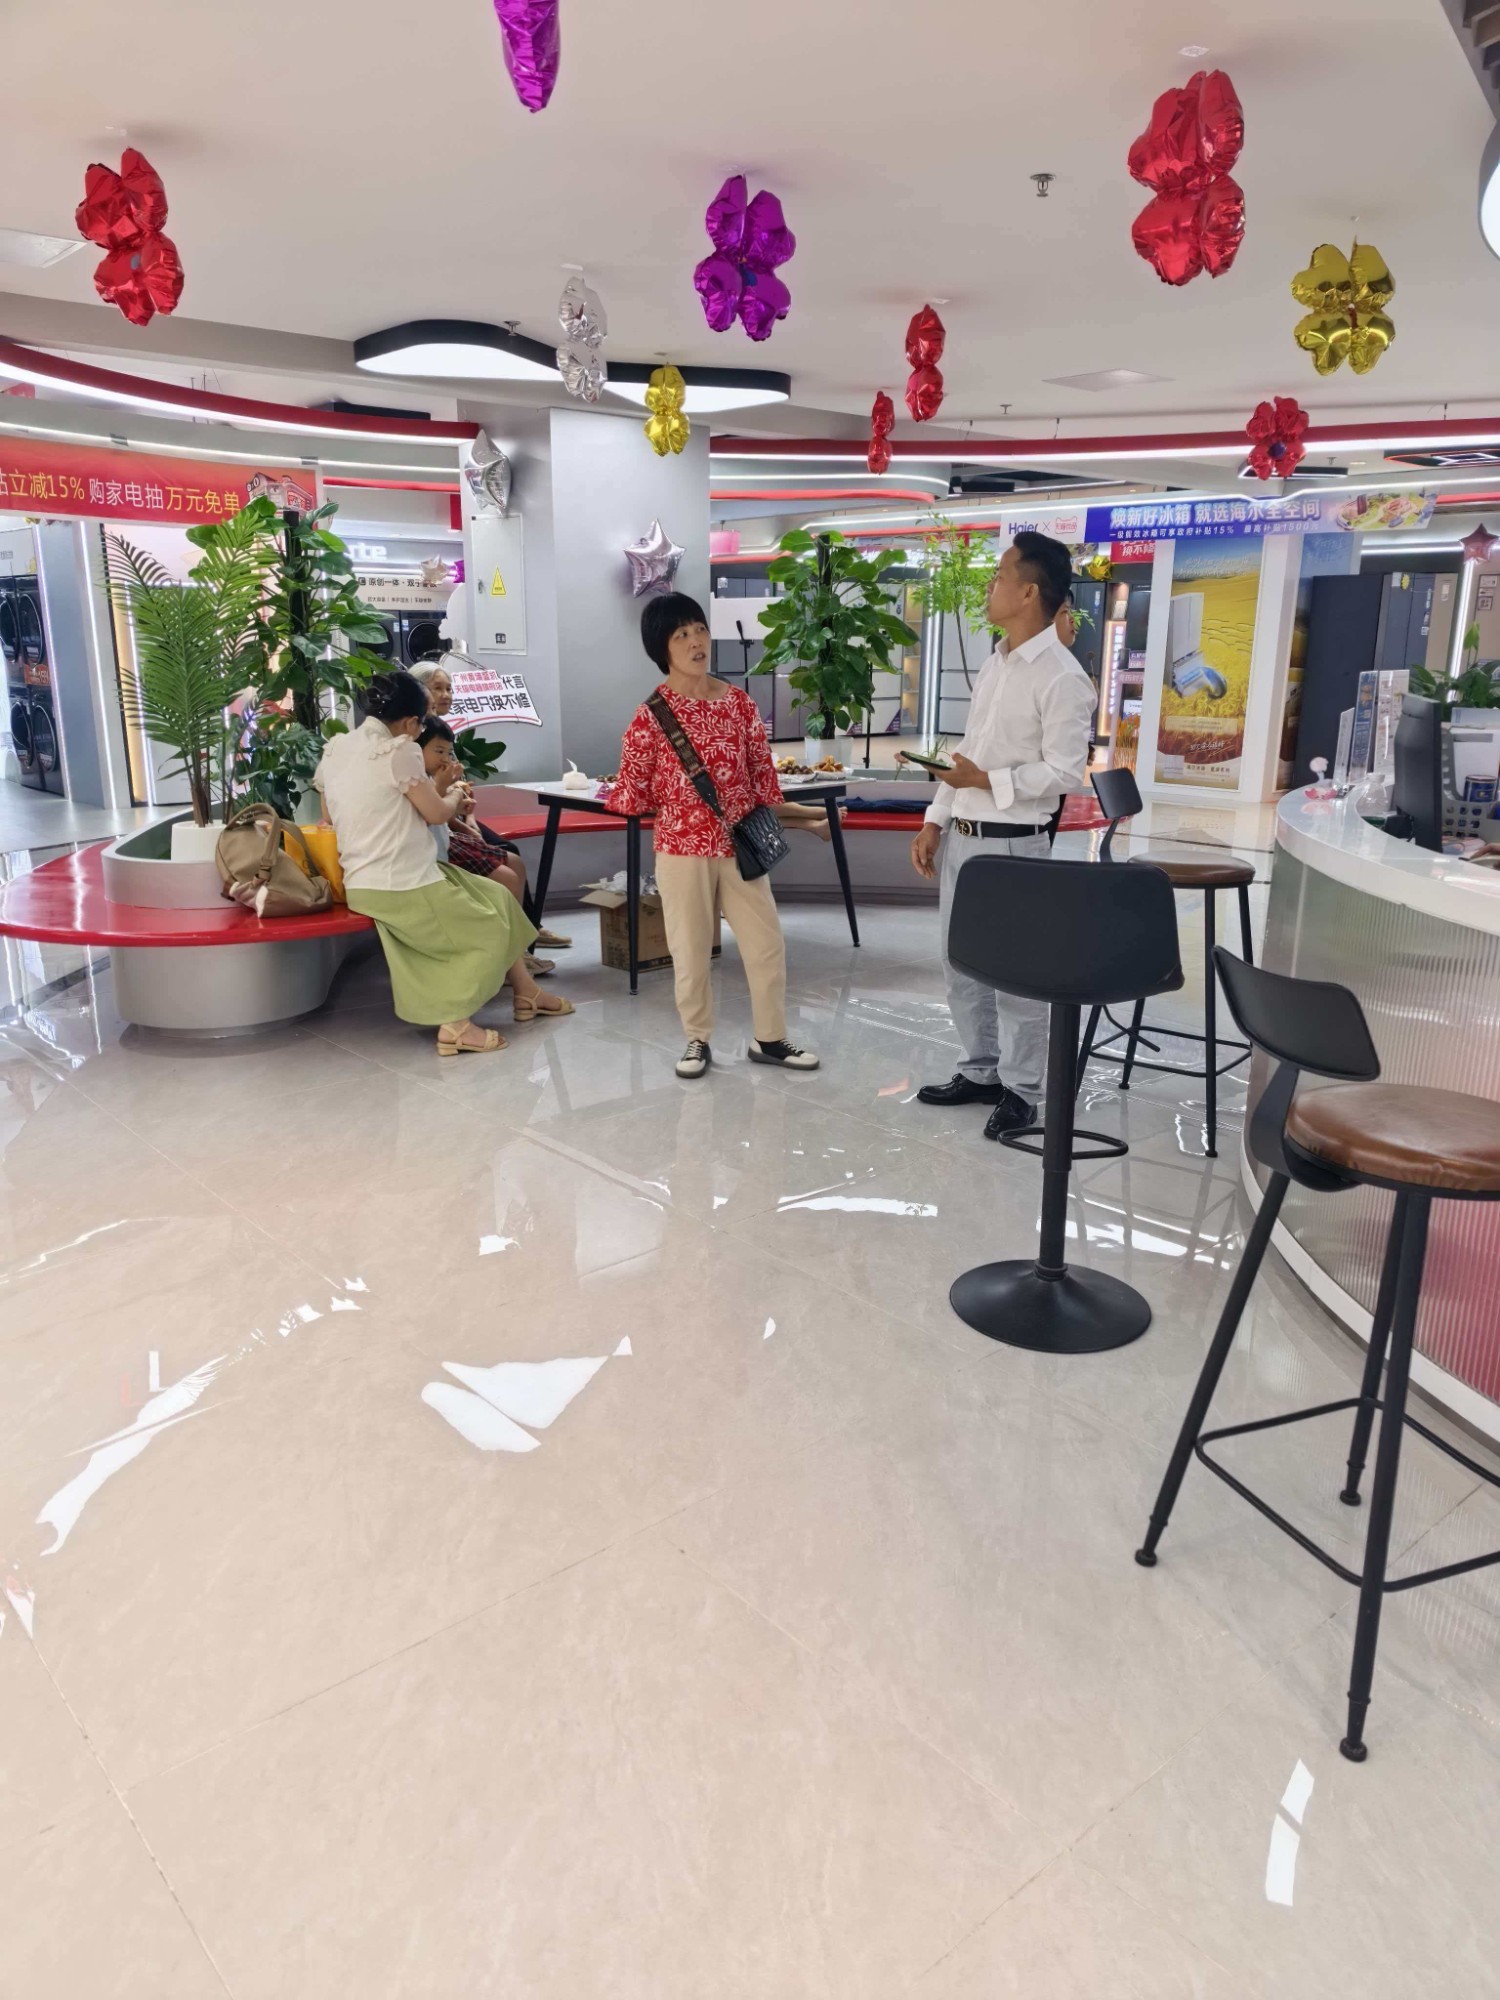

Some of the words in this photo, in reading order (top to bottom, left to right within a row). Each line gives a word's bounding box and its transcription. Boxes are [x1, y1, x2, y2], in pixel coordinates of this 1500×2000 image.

[89, 477, 241, 514] 购家电抽万元免单
[1111, 503, 1191, 528] 焕新好冰箱
[503, 675, 525, 689] 代言
[449, 692, 531, 715] 家电只换不修
